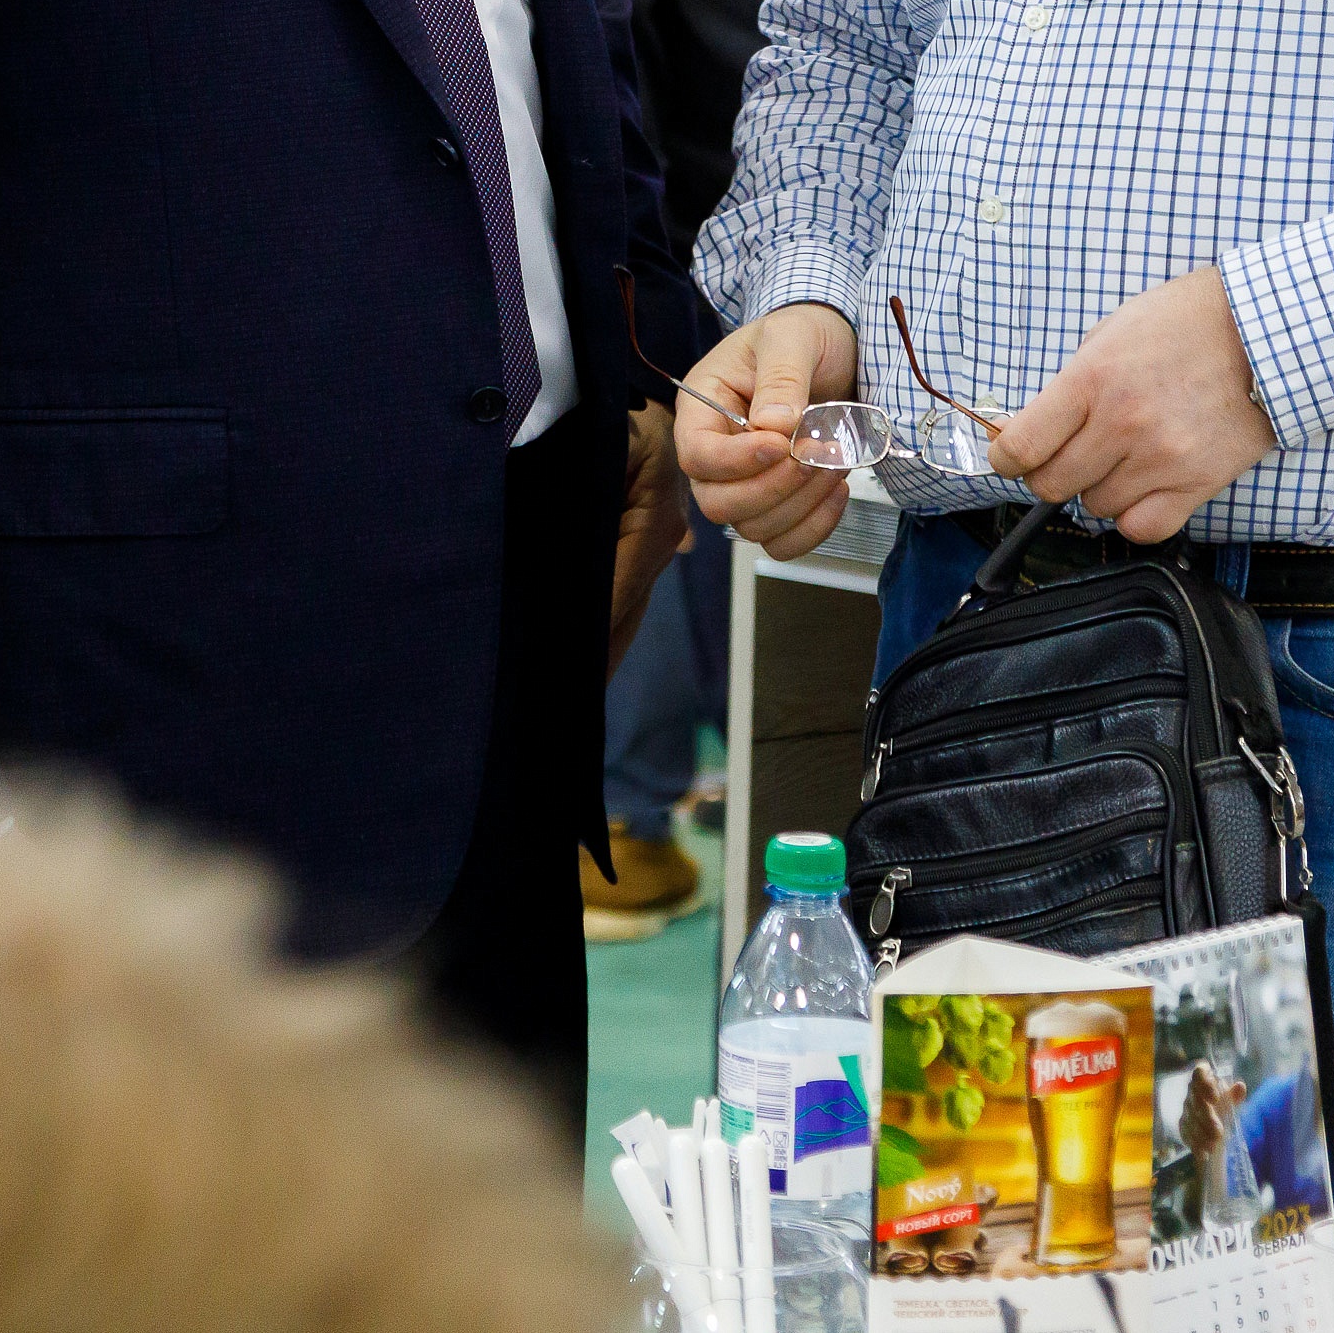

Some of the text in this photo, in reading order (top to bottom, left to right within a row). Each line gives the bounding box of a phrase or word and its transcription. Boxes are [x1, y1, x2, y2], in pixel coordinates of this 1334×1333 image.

[895, 1209, 973, 1235] НОВЫЙ СОРТ
[1259, 1203, 1312, 1243] 2023
[1149, 1221, 1254, 1274] ОЧКАРИ
[1253, 1232, 1312, 1259] ФЕВРАЛ
[1235, 1294, 1242, 1306] 2
[1257, 1287, 1265, 1299] 3
[1237, 1317, 1244, 1329] 9
[1258, 1309, 1270, 1322] 10
